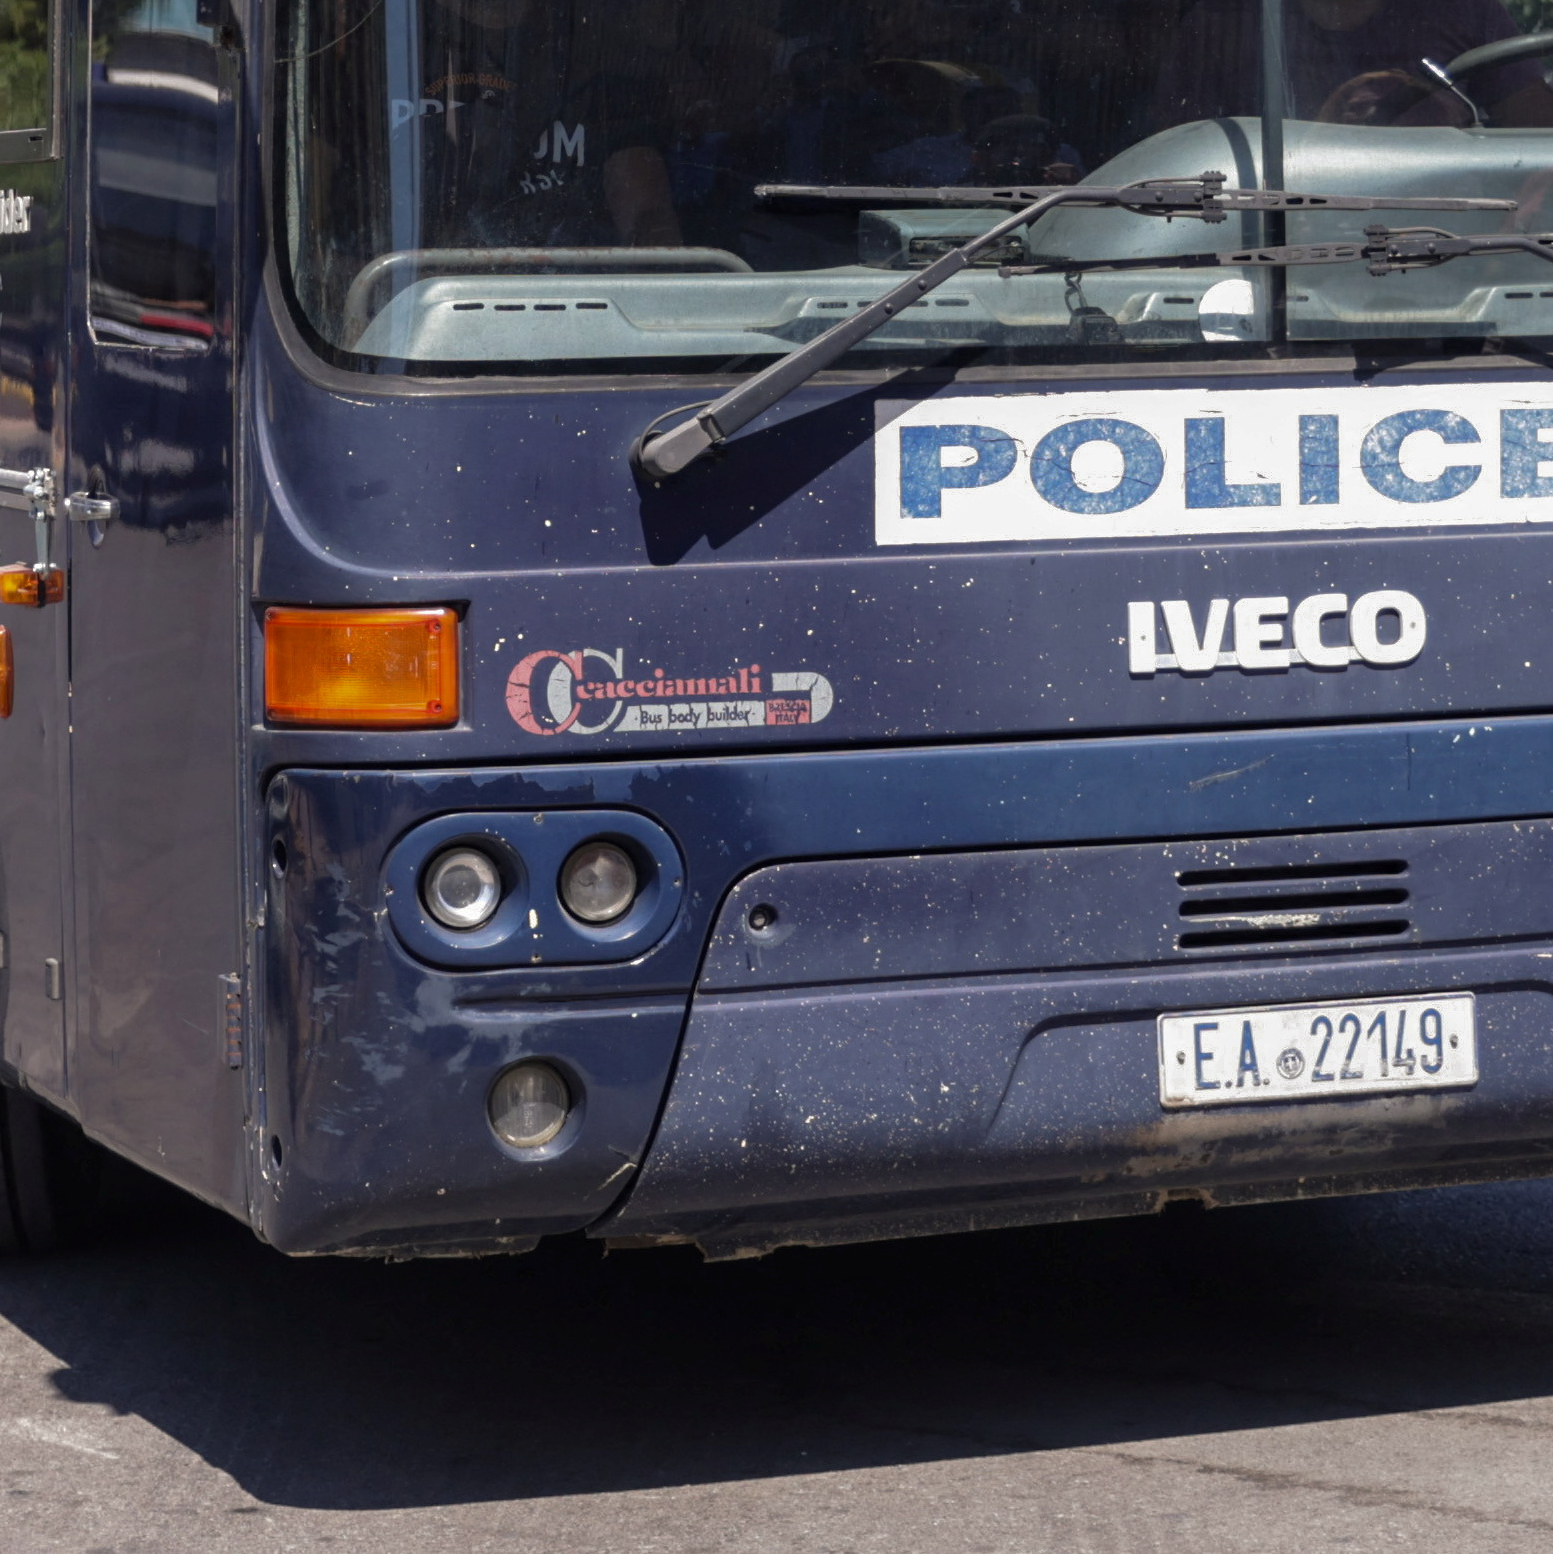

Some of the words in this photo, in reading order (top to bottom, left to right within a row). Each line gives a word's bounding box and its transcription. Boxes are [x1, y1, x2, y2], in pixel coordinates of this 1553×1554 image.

[1128, 590, 1427, 674] IVECO
[641, 711, 662, 724] Bus
[668, 708, 701, 727] body
[707, 706, 751, 722] builder
[1309, 1007, 1444, 1082] 22149
